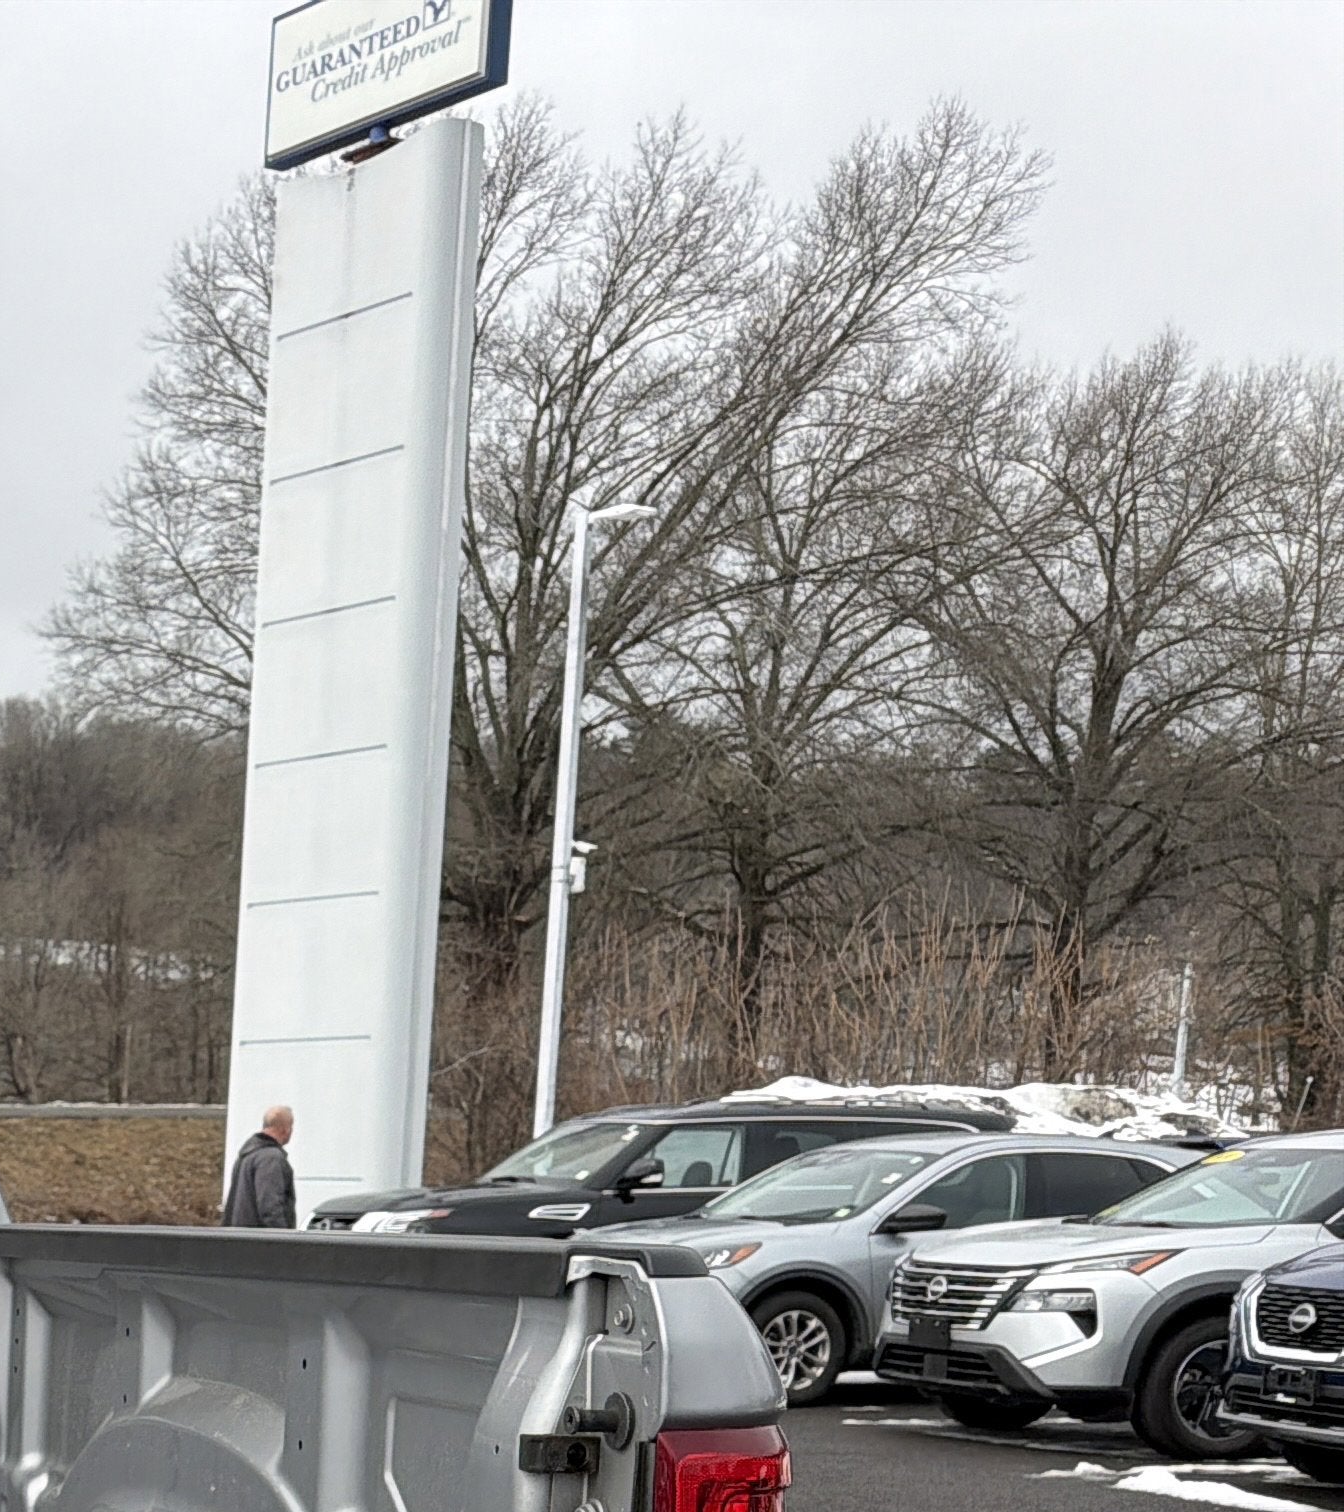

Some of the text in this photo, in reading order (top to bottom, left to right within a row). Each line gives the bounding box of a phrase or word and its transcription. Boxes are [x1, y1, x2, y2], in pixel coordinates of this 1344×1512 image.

[275, 15, 421, 93] GUARANTEED
[310, 19, 463, 103] Credit Approval
